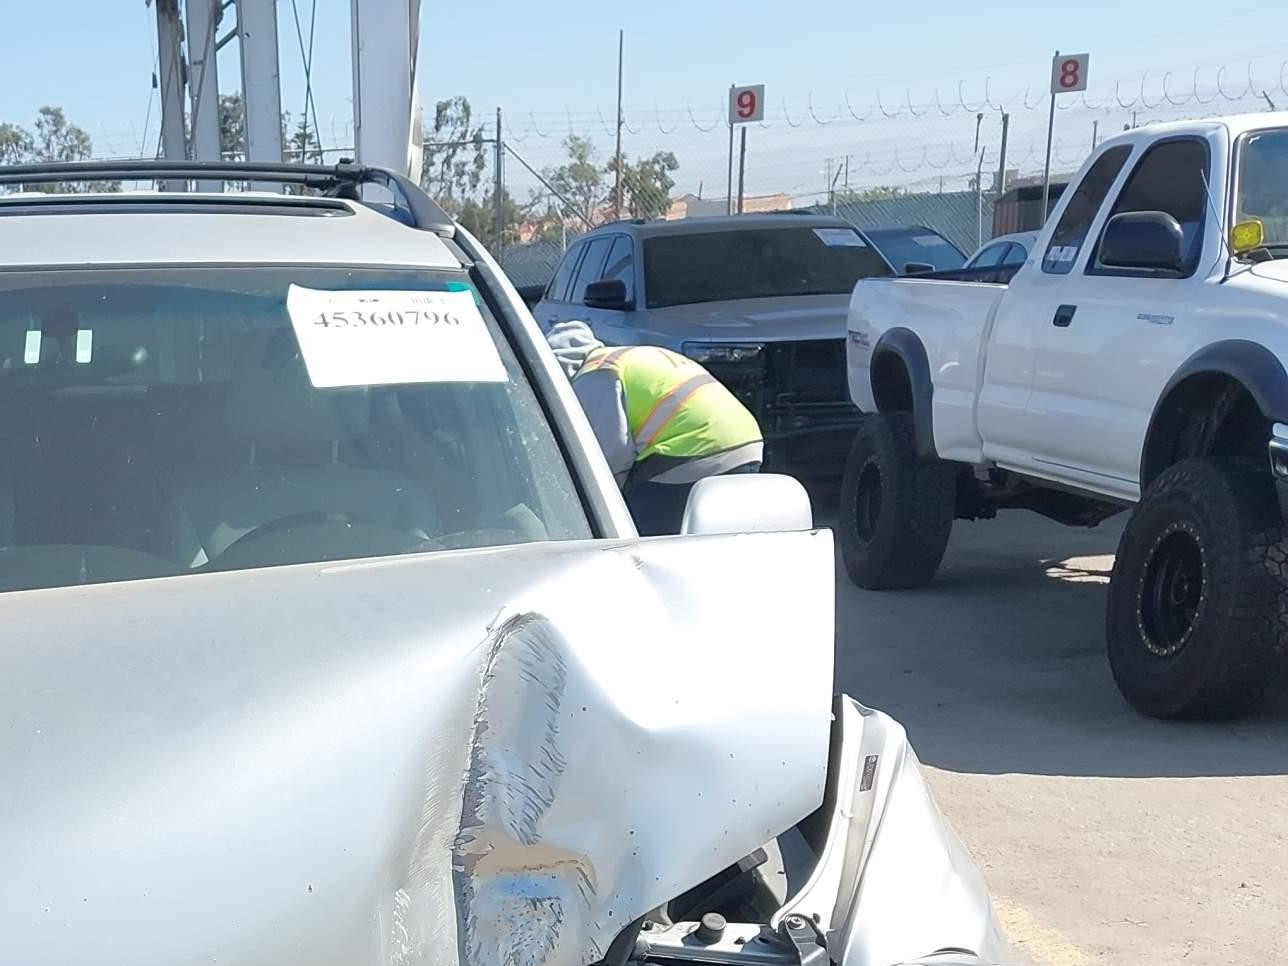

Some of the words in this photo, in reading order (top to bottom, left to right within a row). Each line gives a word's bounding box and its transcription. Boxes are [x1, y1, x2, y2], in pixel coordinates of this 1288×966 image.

[1059, 59, 1080, 88] 8
[737, 90, 756, 119] 9
[313, 310, 460, 328] 45360796
